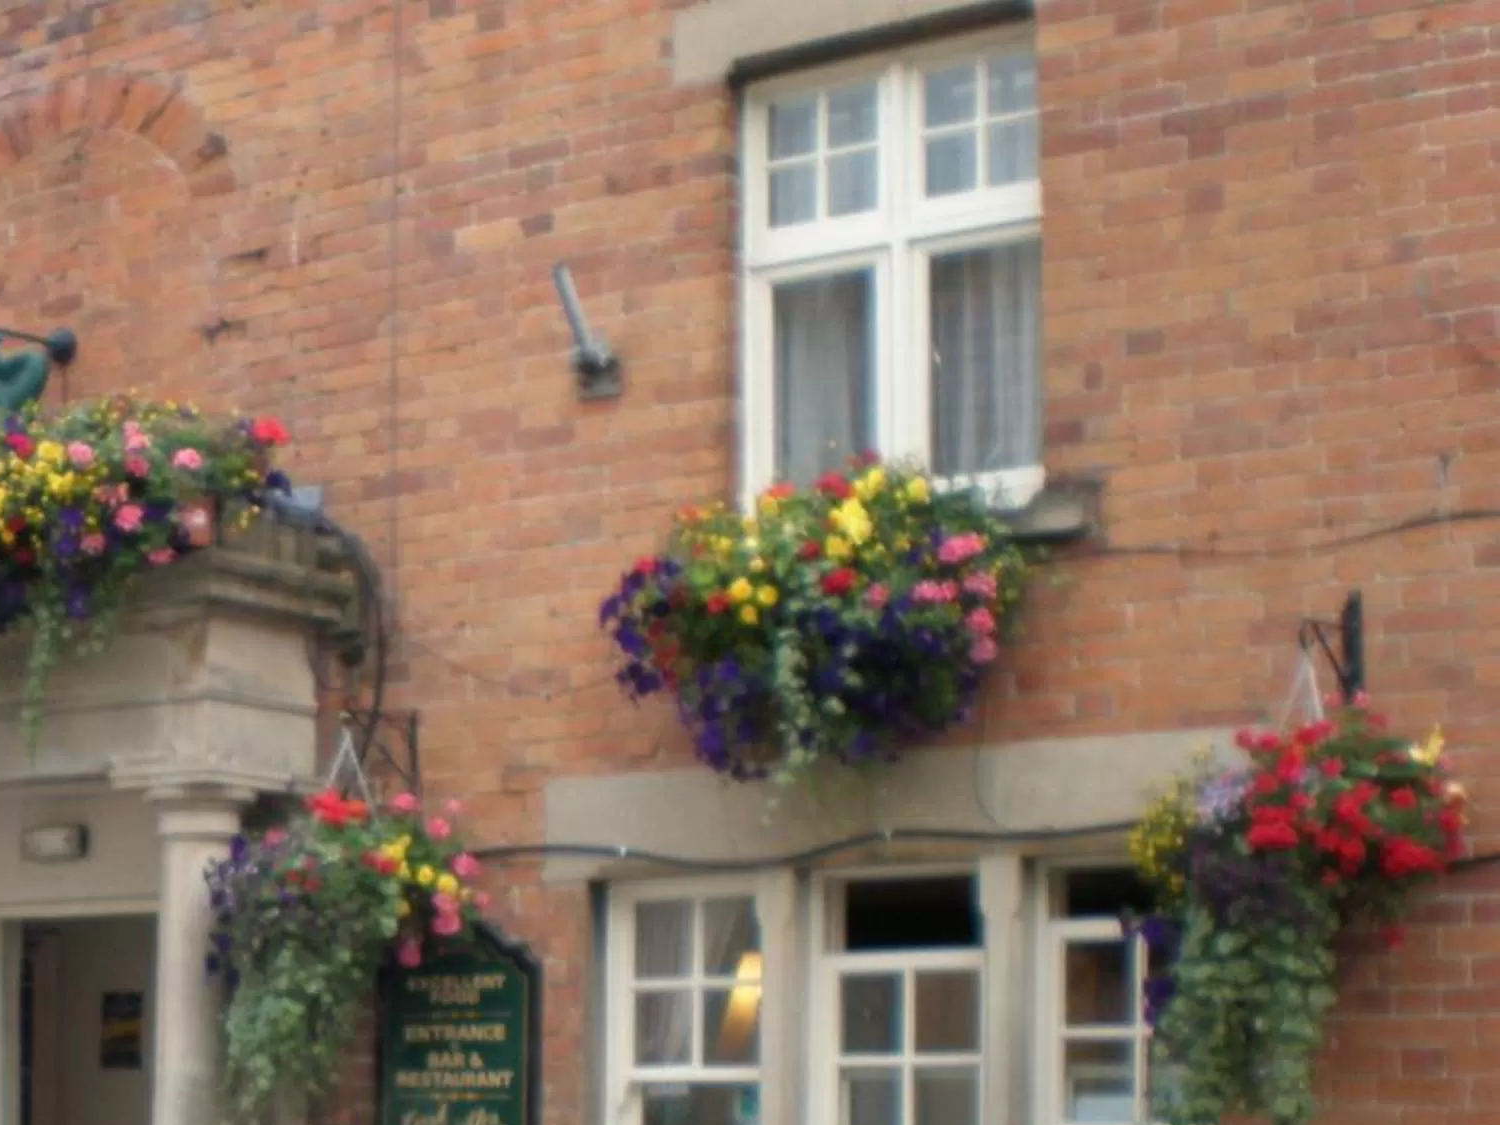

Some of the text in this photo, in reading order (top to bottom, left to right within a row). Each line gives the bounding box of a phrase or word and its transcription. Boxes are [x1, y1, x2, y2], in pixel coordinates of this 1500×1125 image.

[403, 1023, 508, 1042] ENTRANCE
[427, 1050, 485, 1069] BAR &
[394, 1070, 514, 1090] RESTAURANT
